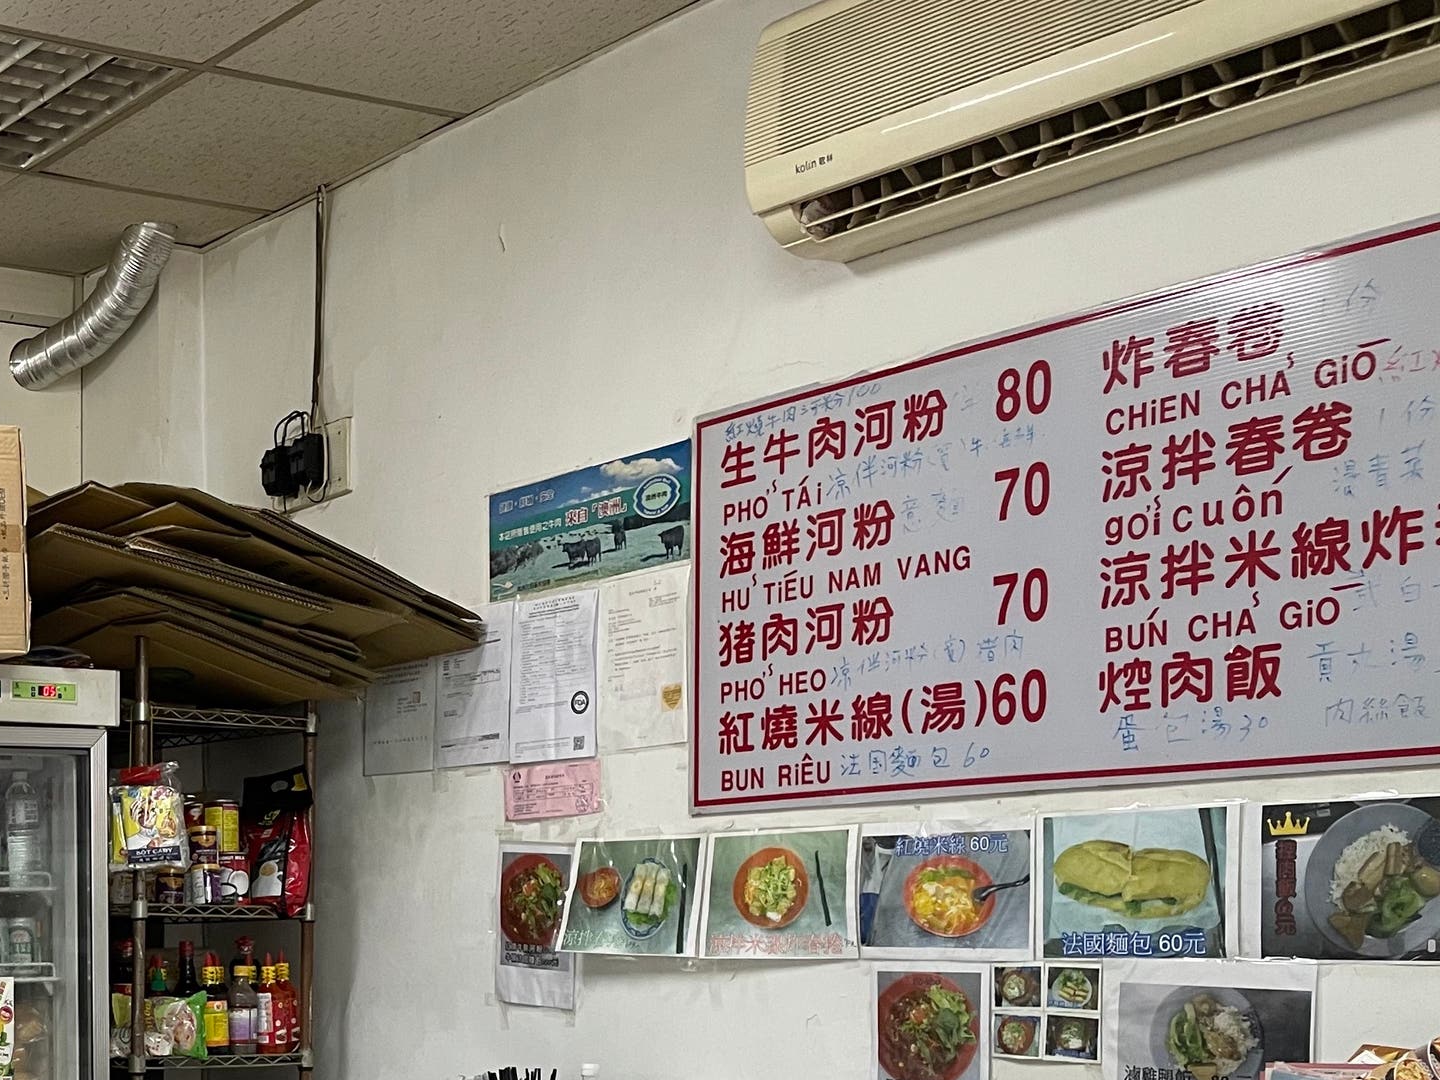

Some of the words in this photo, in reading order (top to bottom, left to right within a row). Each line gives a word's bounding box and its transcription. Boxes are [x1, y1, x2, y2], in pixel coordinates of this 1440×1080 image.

[719, 388, 948, 490] 生牛肉河粉
[995, 358, 1053, 423] 80
[1101, 400, 1354, 504] 涼拌春卷
[719, 499, 896, 580] 海鮮河粉
[994, 461, 1051, 522] 70
[827, 562, 882, 594] NAM
[896, 545, 972, 581] VANG
[1100, 505, 1440, 610] 涼拌米線炸
[718, 596, 895, 668] 猪肉河粉
[992, 567, 1050, 626] 70
[778, 668, 828, 697] HEO
[991, 668, 1049, 725] 60
[720, 765, 765, 793] BUN
[969, 833, 1010, 855] 60元
[1061, 931, 1153, 958] 法國麵包
[1158, 931, 1207, 957] 60元
